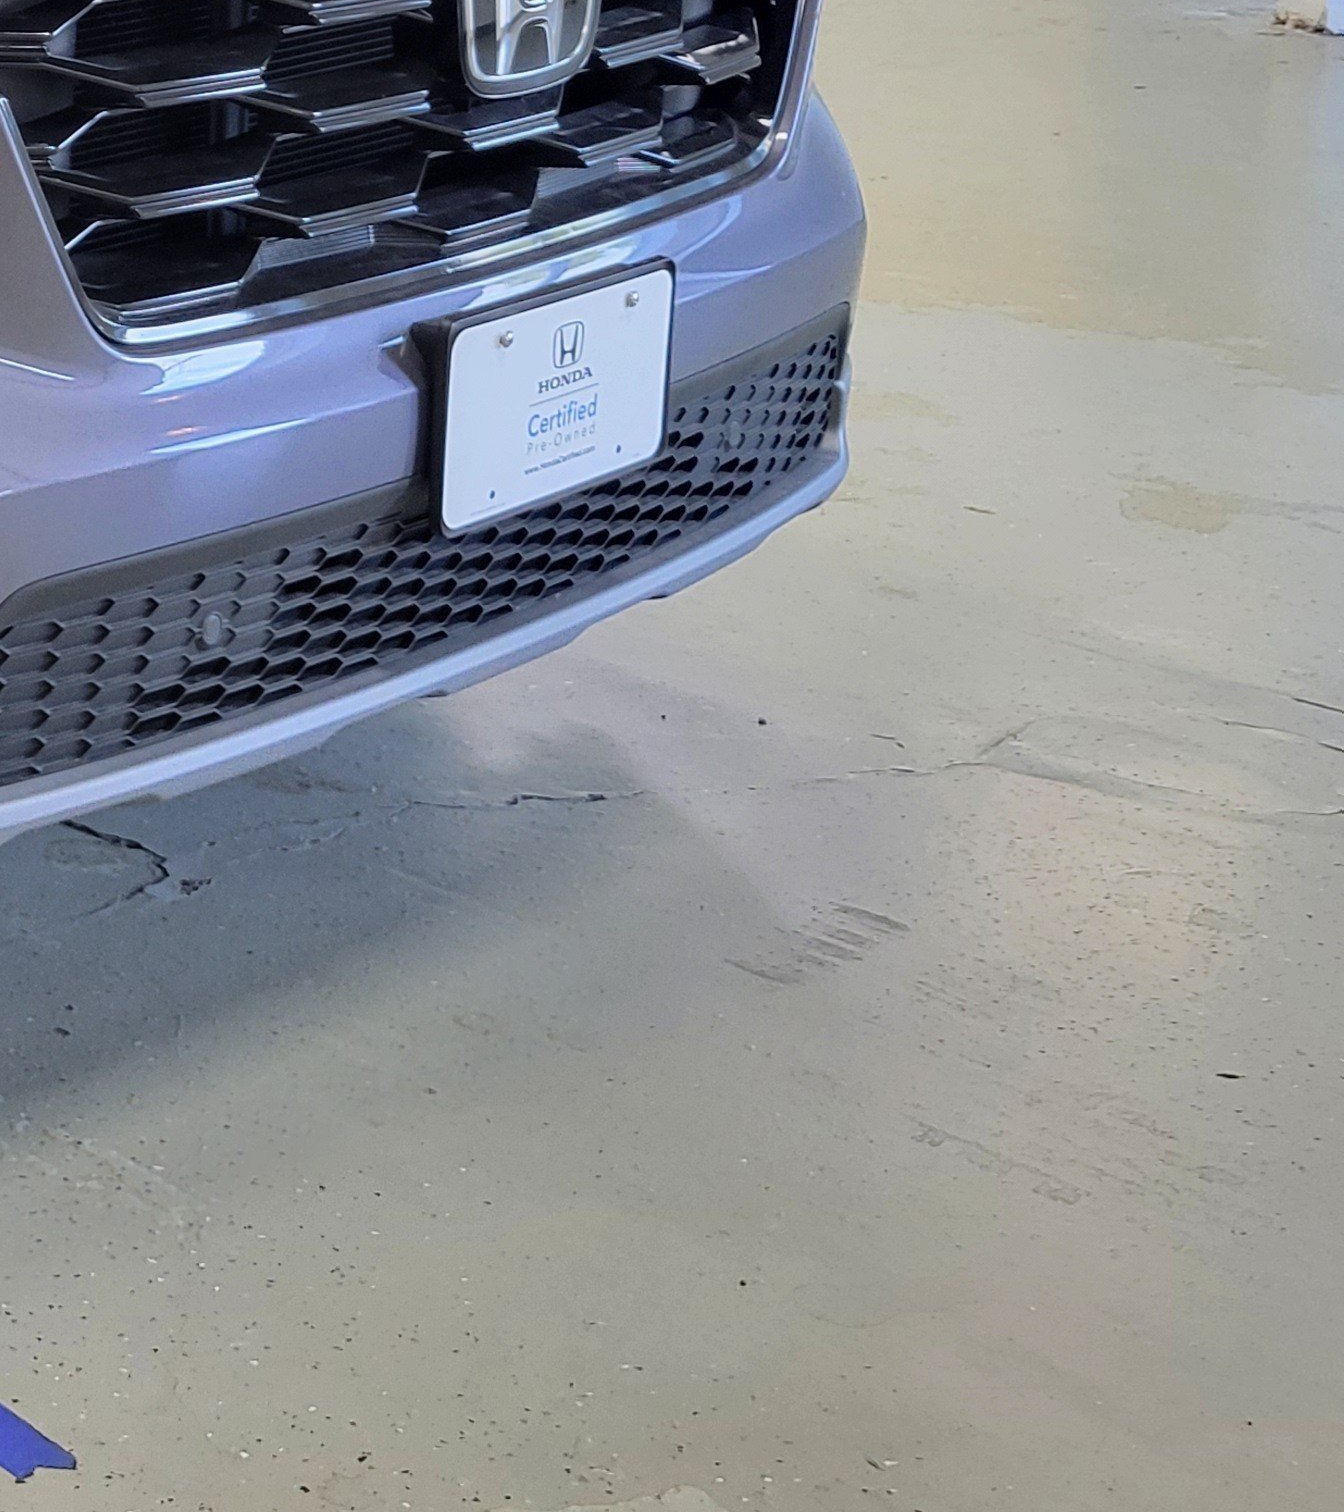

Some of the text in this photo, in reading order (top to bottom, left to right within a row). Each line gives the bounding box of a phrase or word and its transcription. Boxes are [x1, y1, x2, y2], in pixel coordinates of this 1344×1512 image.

[537, 366, 593, 394] HONDA
[527, 392, 598, 437] Certified
[526, 424, 596, 456] Pre-Owned
